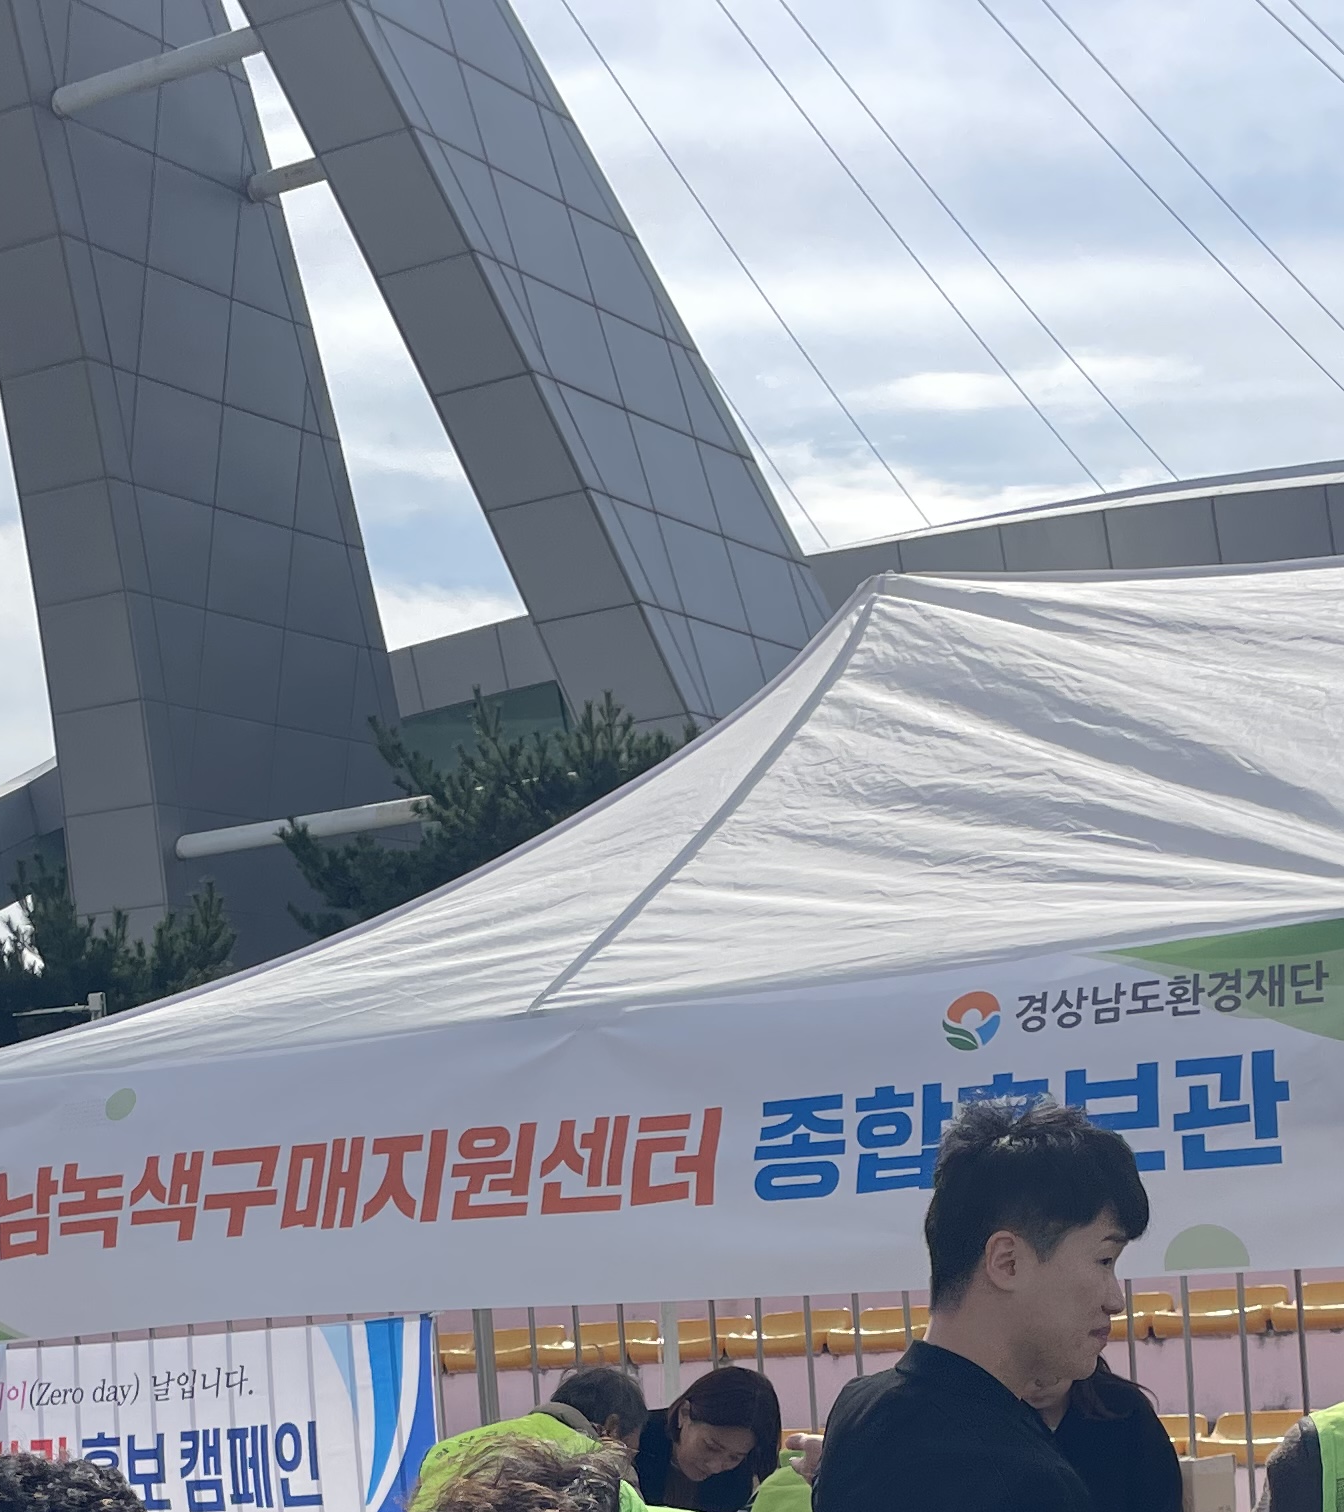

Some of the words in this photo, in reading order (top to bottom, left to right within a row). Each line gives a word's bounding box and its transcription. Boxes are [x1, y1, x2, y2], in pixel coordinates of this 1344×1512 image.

[1015, 960, 1330, 1033] 경상남도환경재단
[754, 1049, 1290, 1201] 종합보관
[92, 1372, 140, 1407] day)
[151, 1364, 255, 1402] 날입니다.
